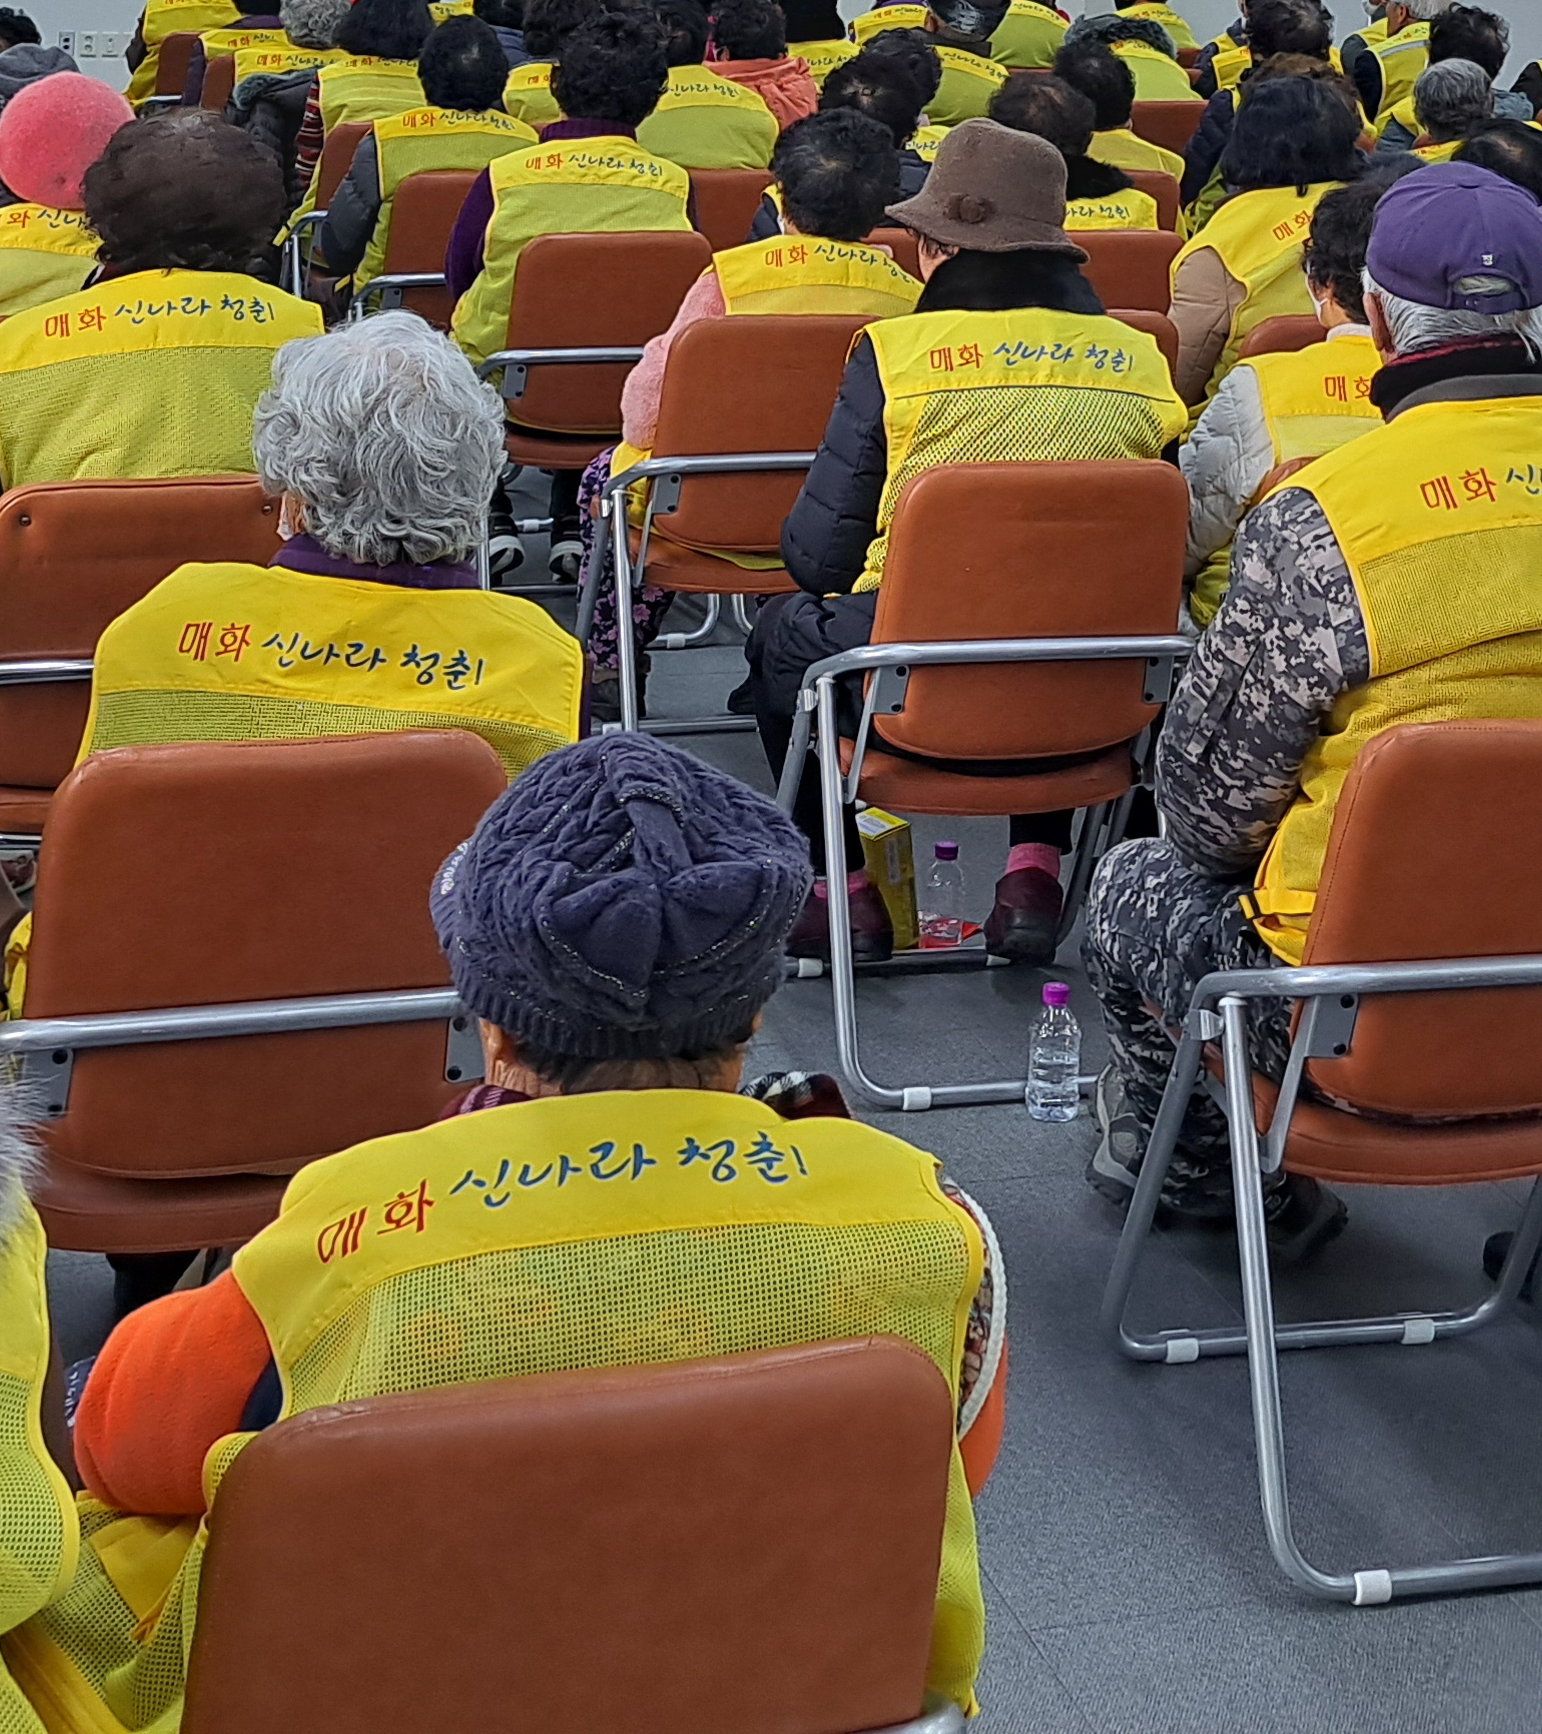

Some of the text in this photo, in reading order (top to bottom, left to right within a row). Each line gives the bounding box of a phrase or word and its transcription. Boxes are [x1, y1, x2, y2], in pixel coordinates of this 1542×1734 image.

[765, 243, 809, 268] 매화
[813, 244, 878, 267] 신나라
[44, 304, 108, 339] 매화
[113, 295, 213, 326] 신나라
[929, 342, 984, 373] 매화
[992, 340, 1075, 367] 신나라
[1419, 466, 1497, 511] 매화
[177, 621, 484, 691] 매화 신나라 청춘!
[316, 1130, 809, 1265] 매화 신나라 청춘!
